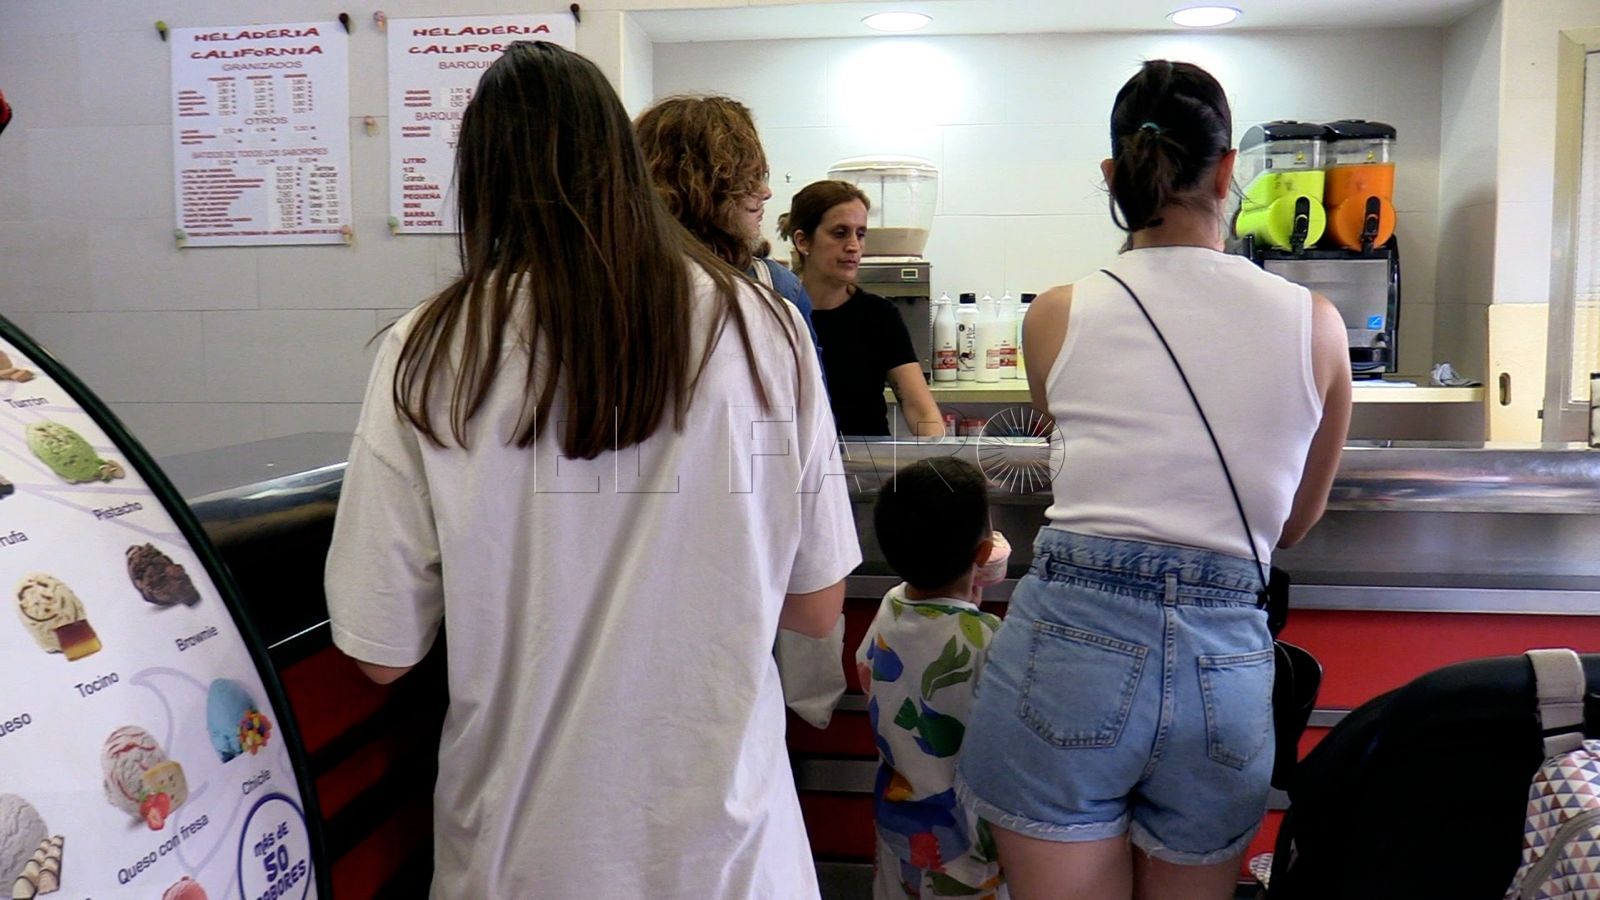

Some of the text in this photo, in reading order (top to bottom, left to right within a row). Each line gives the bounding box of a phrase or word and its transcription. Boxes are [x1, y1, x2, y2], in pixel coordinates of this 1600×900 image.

[194, 27, 320, 42] HELADERIA
[413, 24, 550, 36] HELADERIA
[190, 45, 323, 59] CALIFORNIA
[408, 43, 506, 54] CALIFOR
[222, 60, 303, 71] GRANIZADOS
[245, 116, 288, 125] OTROS
[5, 395, 49, 409] Turrón
[92, 501, 143, 521] Pistacho
[0, 530, 29, 546] rufa
[175, 625, 219, 652] Brownie
[74, 671, 120, 698] Tocino
[0, 712, 32, 738] ueso
[242, 769, 271, 796] Chicle
[118, 814, 209, 886] Queso con fresa
[263, 843, 289, 882] 50
[257, 859, 306, 900] ABORES
